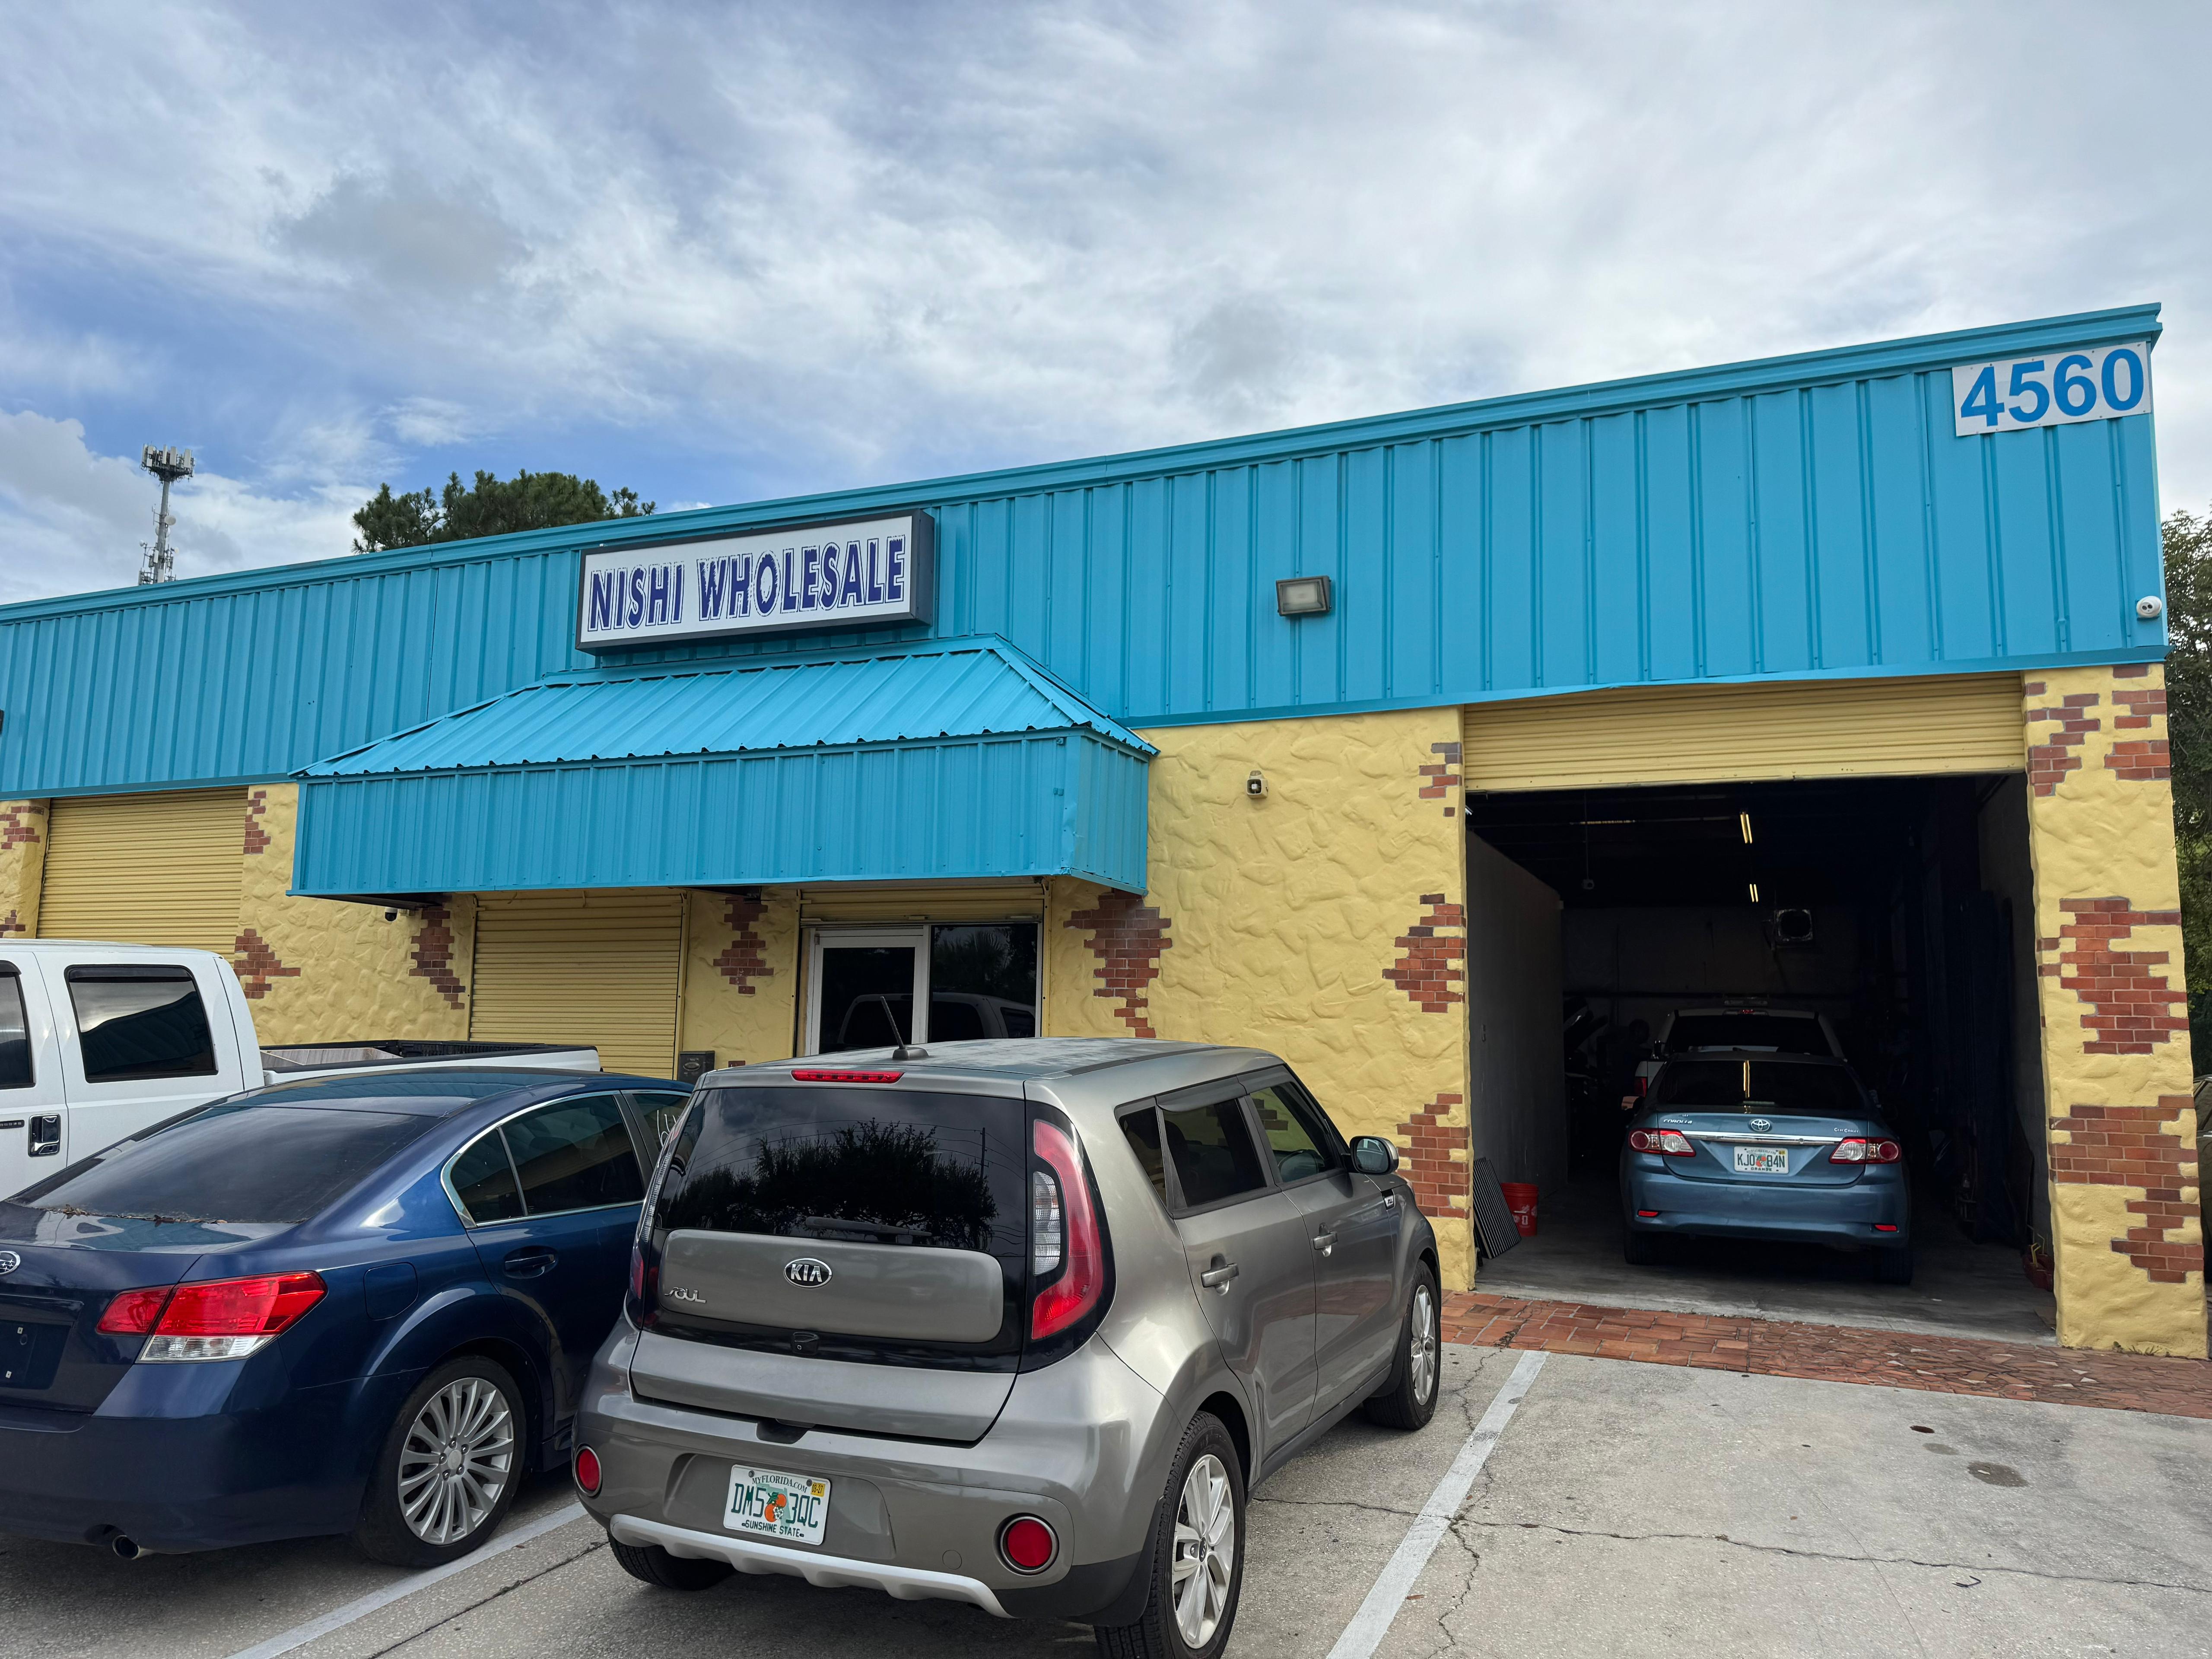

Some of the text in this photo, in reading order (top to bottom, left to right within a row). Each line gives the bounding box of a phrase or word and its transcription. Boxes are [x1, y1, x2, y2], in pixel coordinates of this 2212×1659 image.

[1960, 348, 2144, 427] 4560
[587, 534, 906, 632] NISHI WHOLESALE
[790, 1263, 823, 1283] KIA
[664, 1287, 707, 1304] SOUL
[752, 1475, 807, 1493] MYFLORIDA.COM
[785, 1493, 821, 1528] 3QC
[745, 1519, 801, 1537] SUNSHINE STATE
